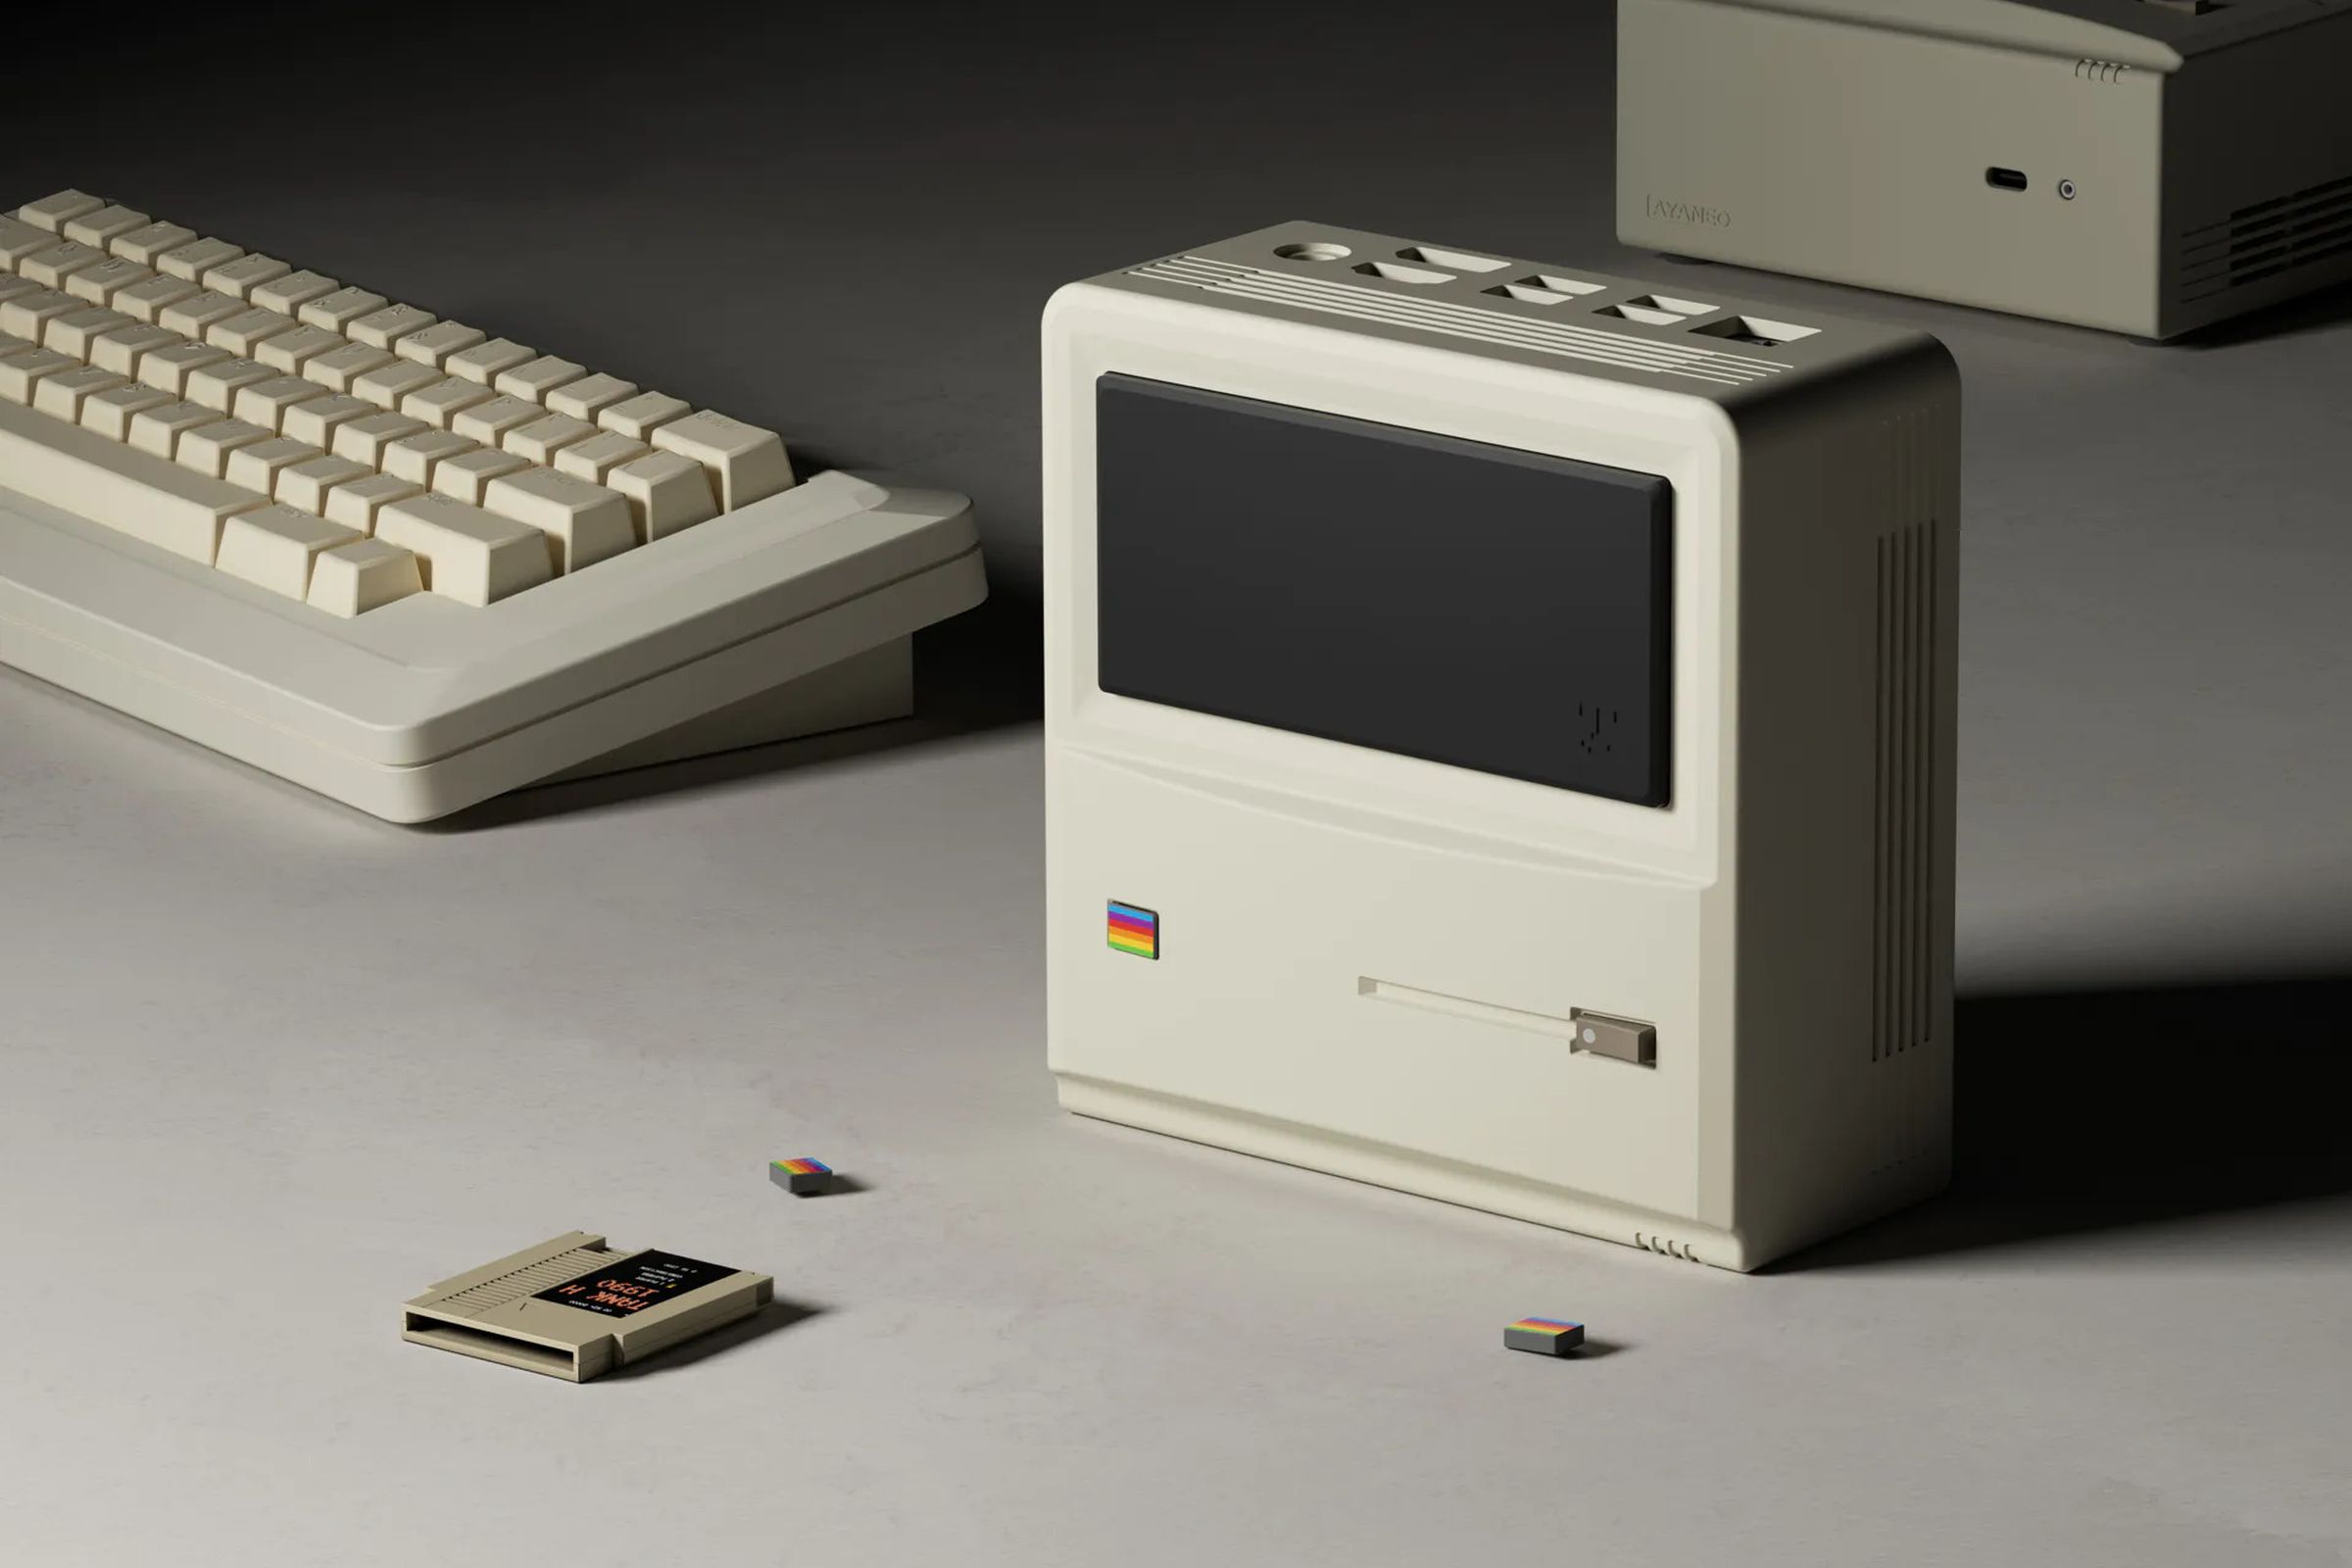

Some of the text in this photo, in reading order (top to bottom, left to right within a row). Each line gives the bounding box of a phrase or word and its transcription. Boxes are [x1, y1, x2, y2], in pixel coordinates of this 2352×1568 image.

[1651, 199, 1732, 227] AYANEO
[596, 1279, 660, 1298] 1990
[586, 1290, 650, 1311] TANK
